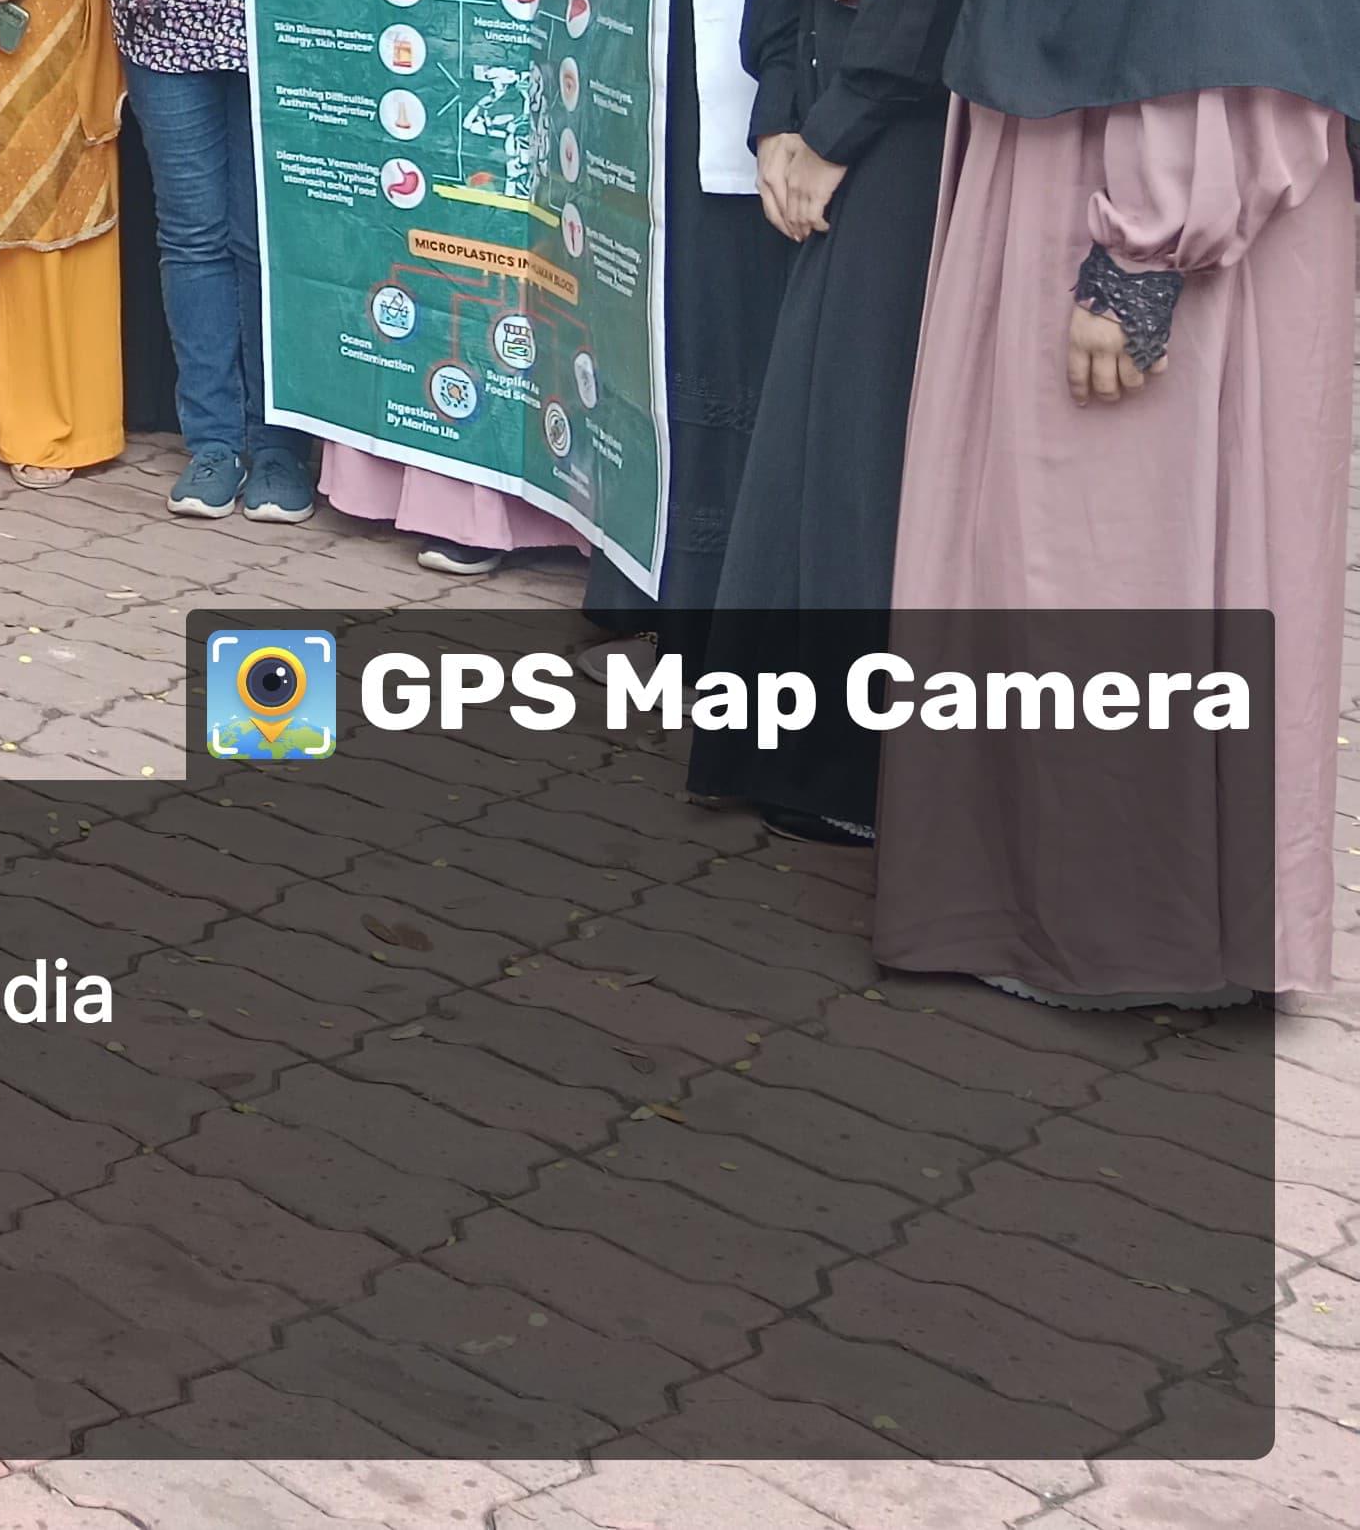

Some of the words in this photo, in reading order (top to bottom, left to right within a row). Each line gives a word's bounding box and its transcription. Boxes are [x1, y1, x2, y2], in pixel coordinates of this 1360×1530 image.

[274, 22, 295, 32] Skin
[315, 38, 336, 48] Skin
[337, 41, 374, 52] Cancer
[276, 85, 324, 101] Breathing
[308, 112, 348, 125] Problem
[307, 189, 353, 207] Poisoning
[415, 238, 515, 267] MICROPLASTICS
[340, 333, 373, 350] Ocean
[340, 346, 416, 374] Contamination
[485, 383, 511, 399] Food
[388, 400, 438, 421] Ingestion
[387, 413, 400, 426] By
[402, 417, 439, 436] Marine
[440, 425, 460, 440] Life
